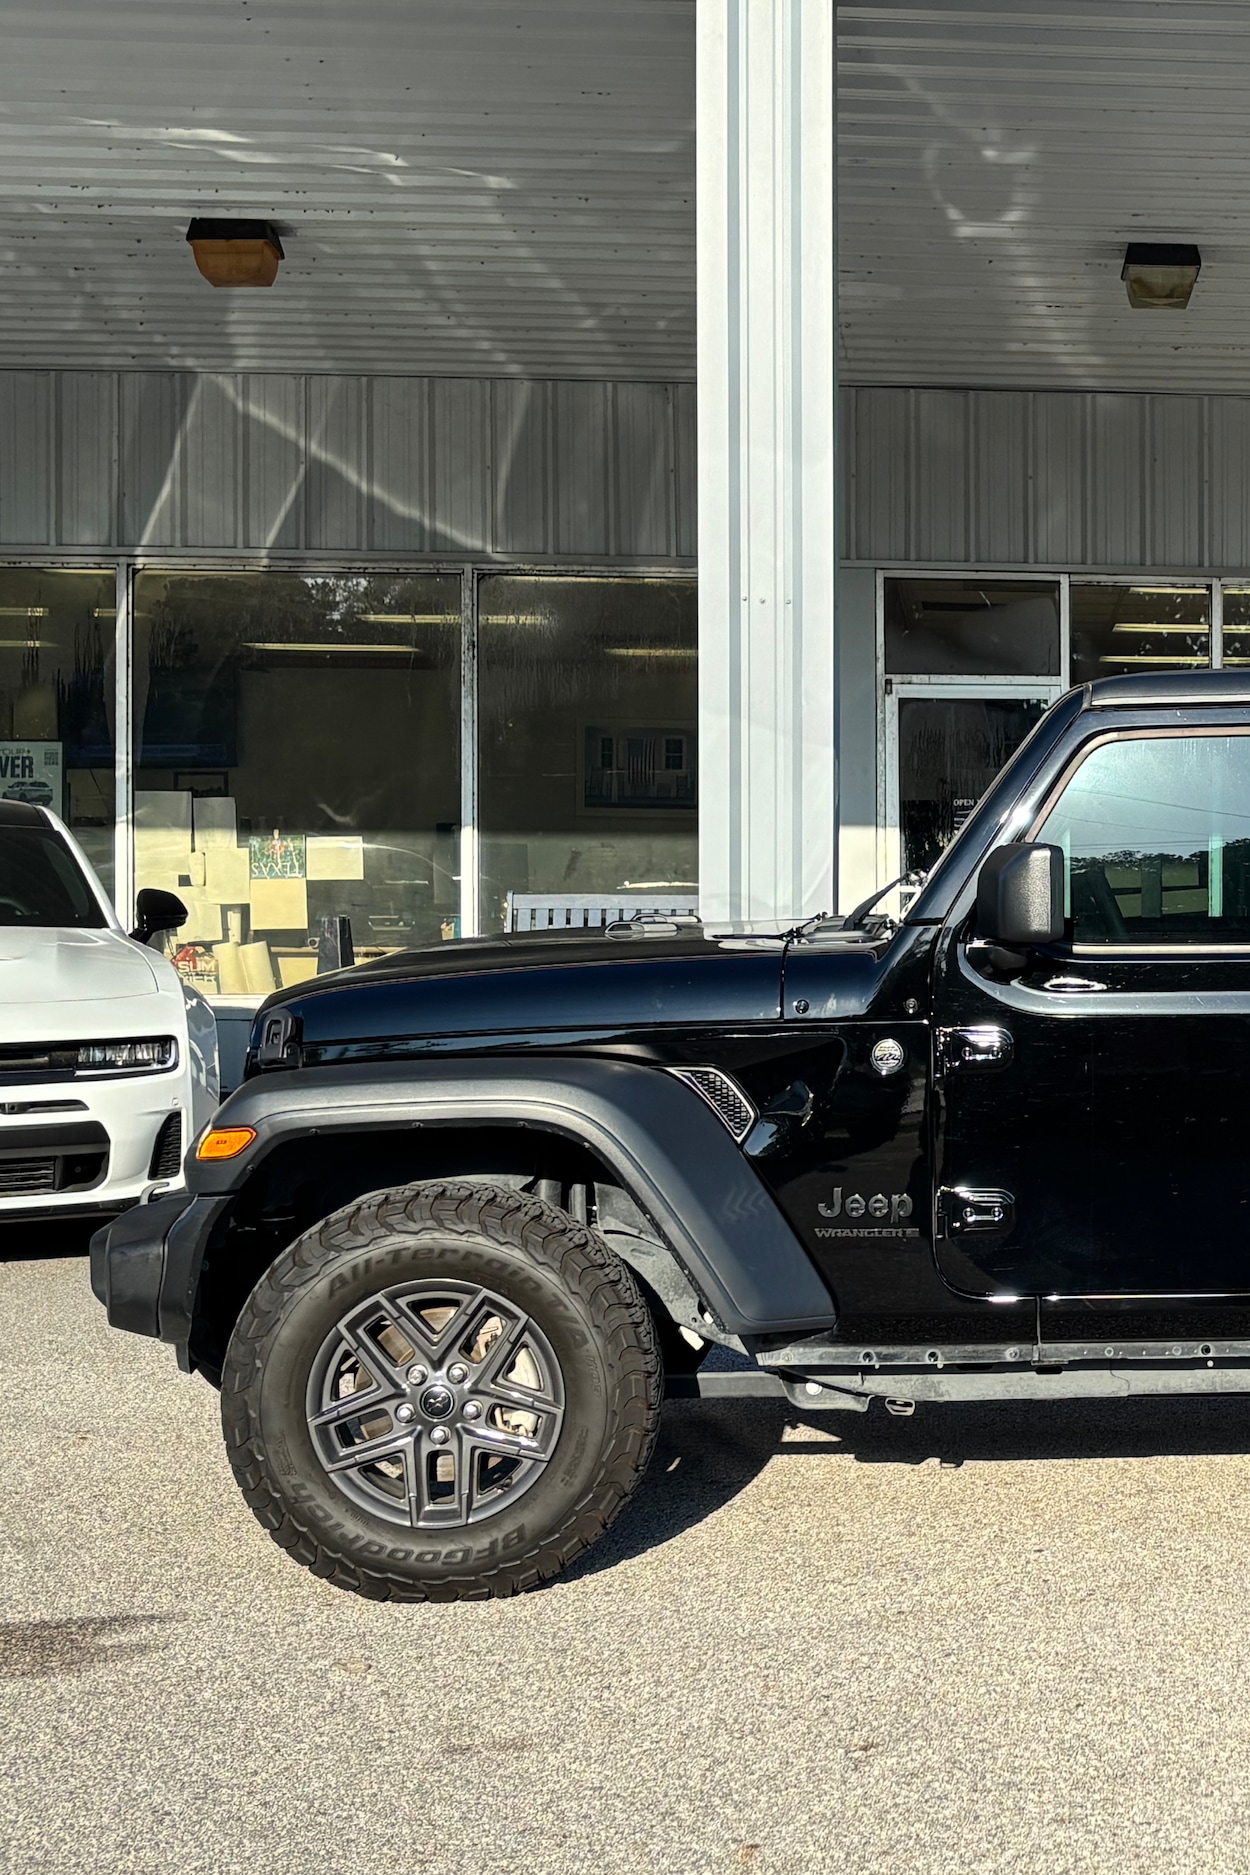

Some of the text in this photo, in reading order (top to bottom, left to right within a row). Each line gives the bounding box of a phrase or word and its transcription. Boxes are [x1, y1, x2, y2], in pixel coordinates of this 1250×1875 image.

[953, 798, 975, 807] OPEN
[251, 861, 303, 879] TEXAS
[817, 1187, 913, 1224] Jeep
[814, 1227, 904, 1238] WRANGLER
[328, 1245, 543, 1297] All-Terrain
